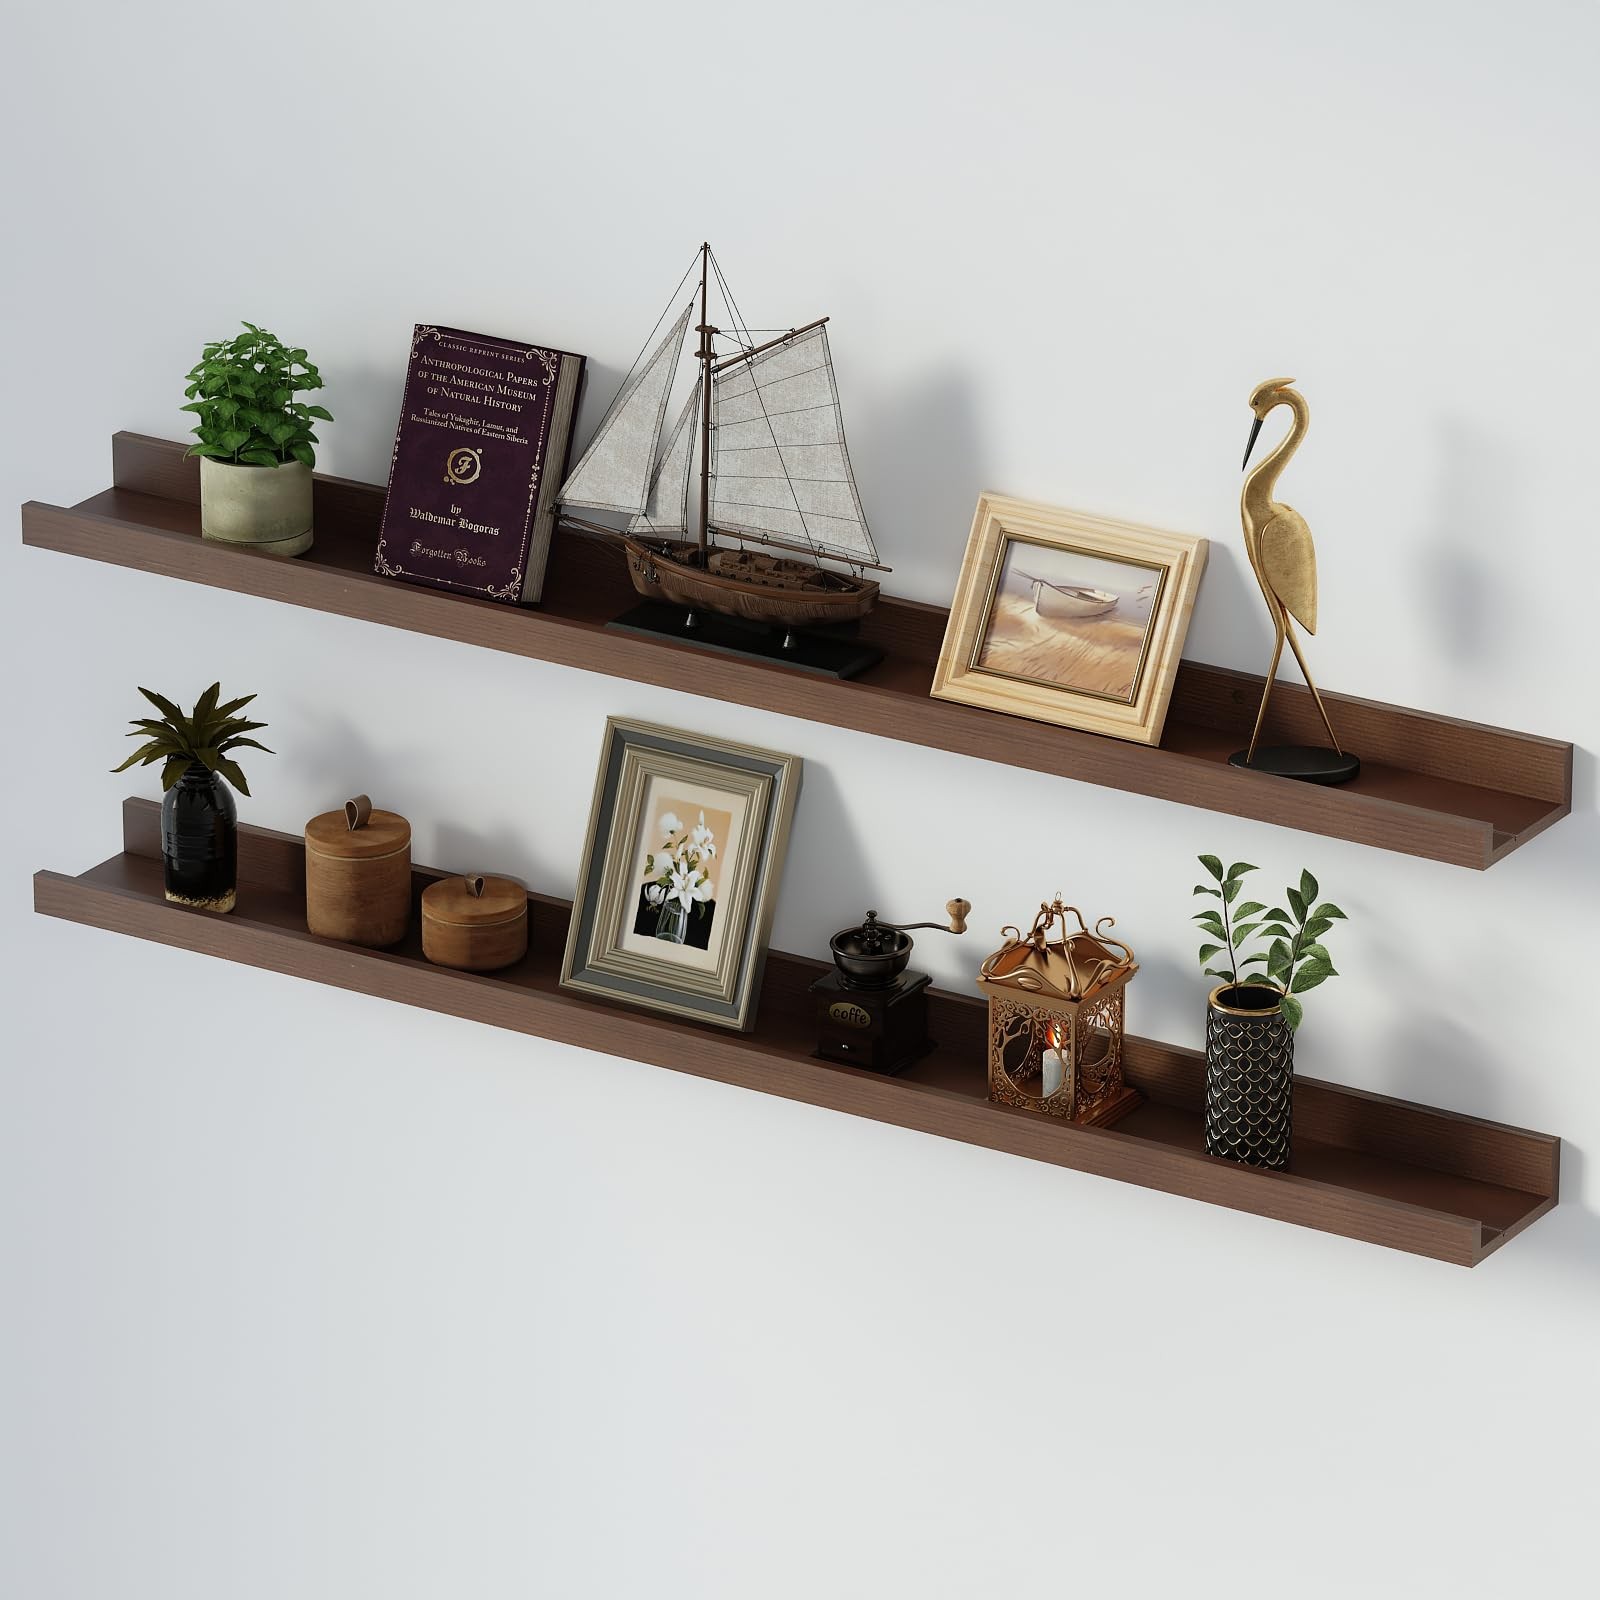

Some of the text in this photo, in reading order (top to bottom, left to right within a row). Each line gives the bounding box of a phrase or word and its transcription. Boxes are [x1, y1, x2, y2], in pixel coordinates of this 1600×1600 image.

[438, 341, 525, 364] CLASSIC REPRINT SERIES
[410, 413, 528, 445] Russianized Natives of Eastern Siberia
[423, 407, 440, 418] Tales
[441, 412, 450, 420] of
[505, 426, 518, 434] and
[409, 507, 500, 536] Waldemar Bogoras
[450, 504, 462, 516] by
[409, 539, 487, 568] Forgotten Books
[833, 1007, 867, 1024] coffe
